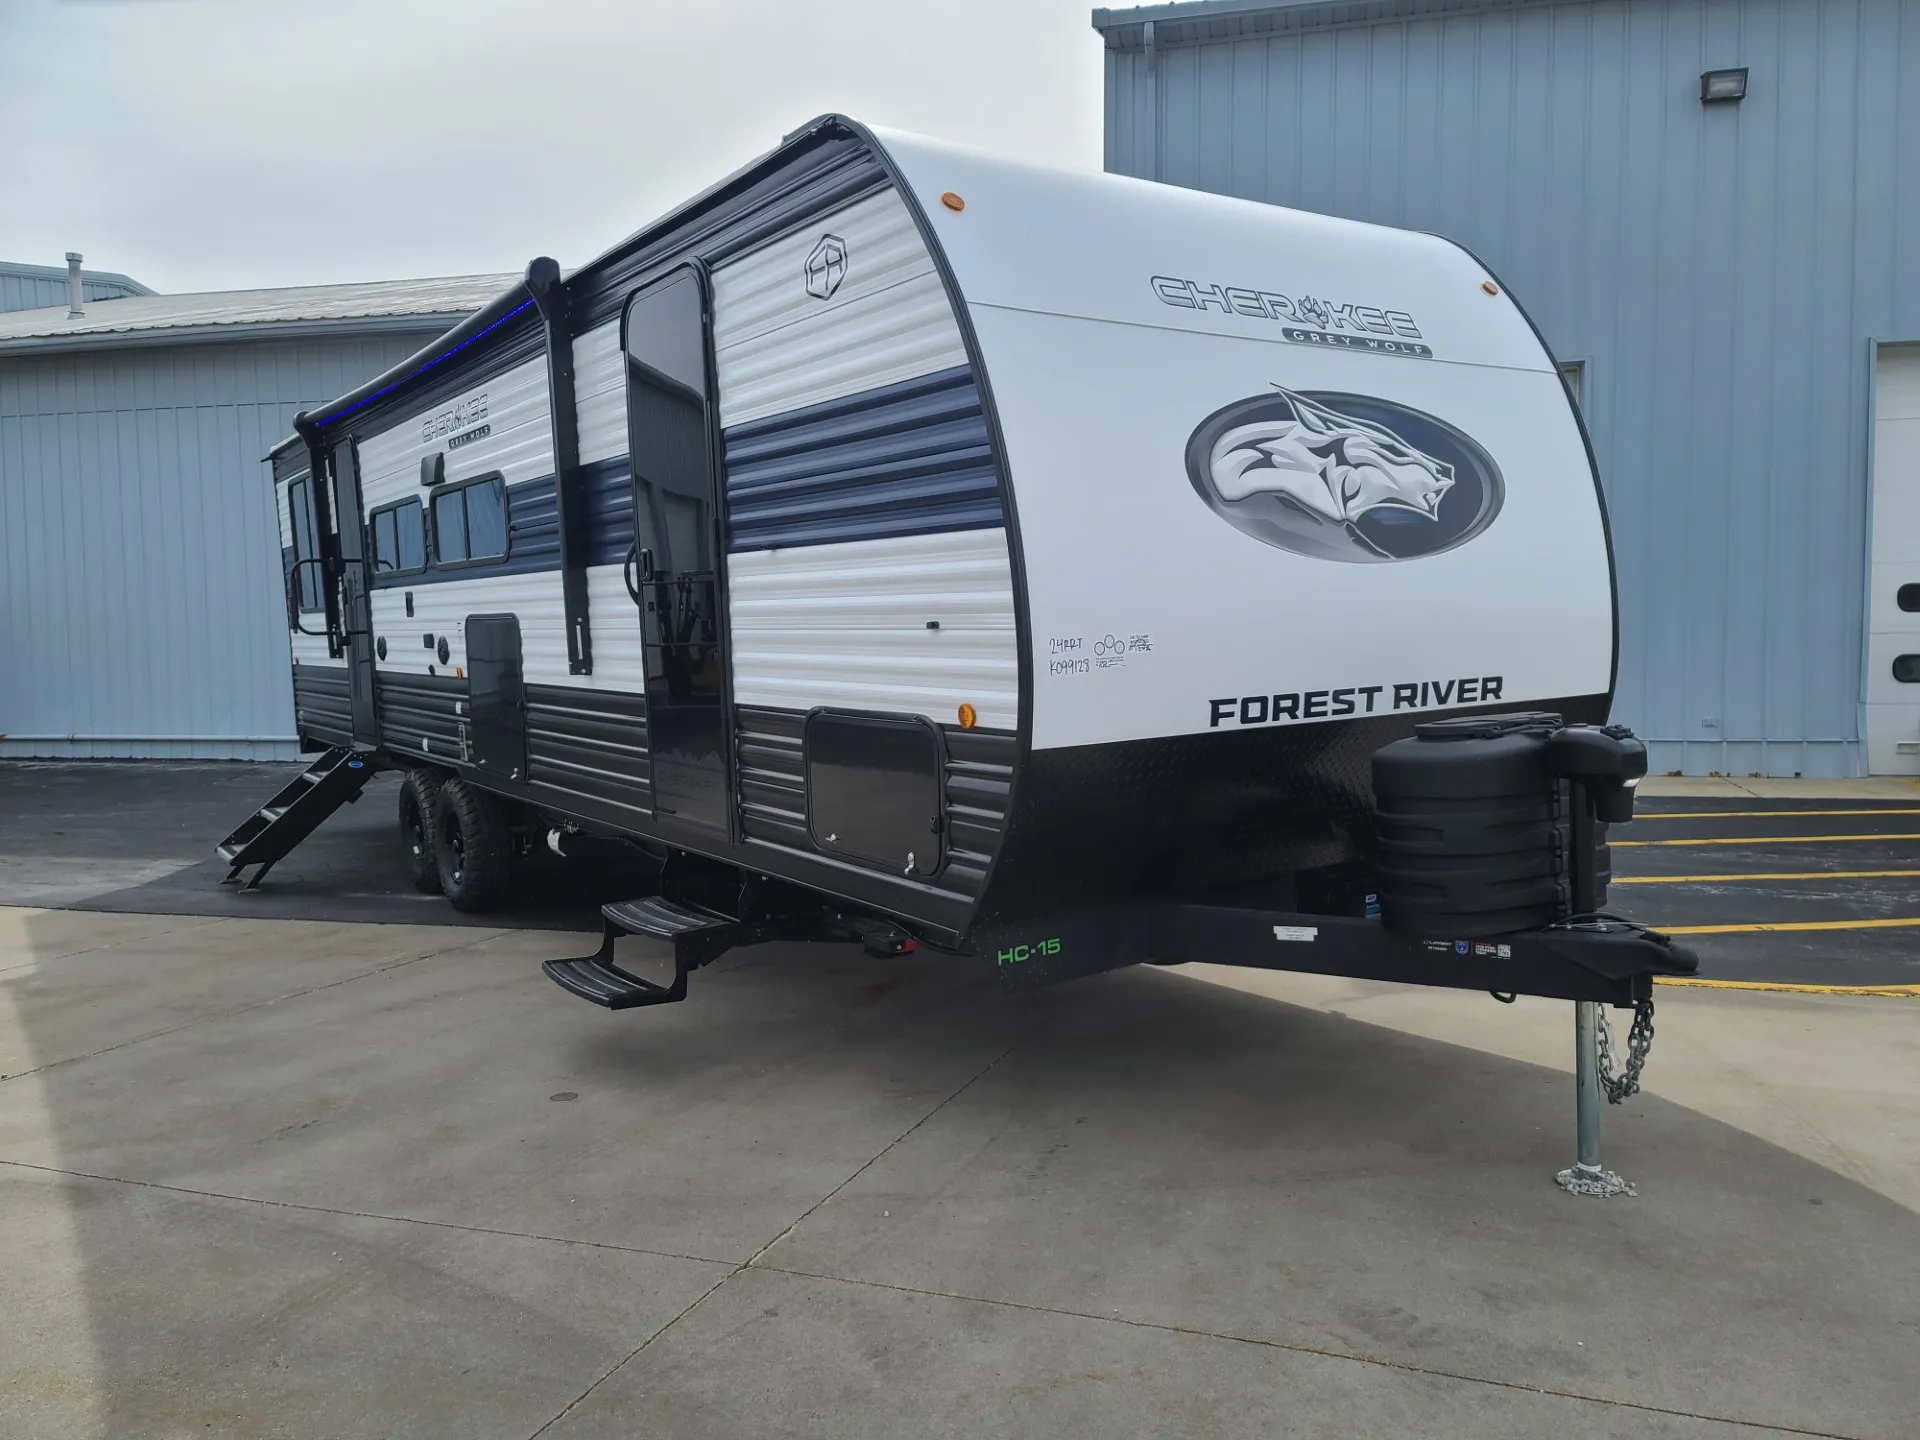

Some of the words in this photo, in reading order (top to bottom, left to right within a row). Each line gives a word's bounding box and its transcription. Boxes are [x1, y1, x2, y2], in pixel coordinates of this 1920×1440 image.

[1150, 275, 1423, 339] CHEROKEE
[1292, 330, 1352, 346] GREY
[1368, 339, 1424, 355] WOLF
[470, 426, 489, 439] WOLF
[1207, 685, 1384, 728] FOREST
[1391, 675, 1504, 711] RIVER
[997, 938, 1061, 967] HC-15
